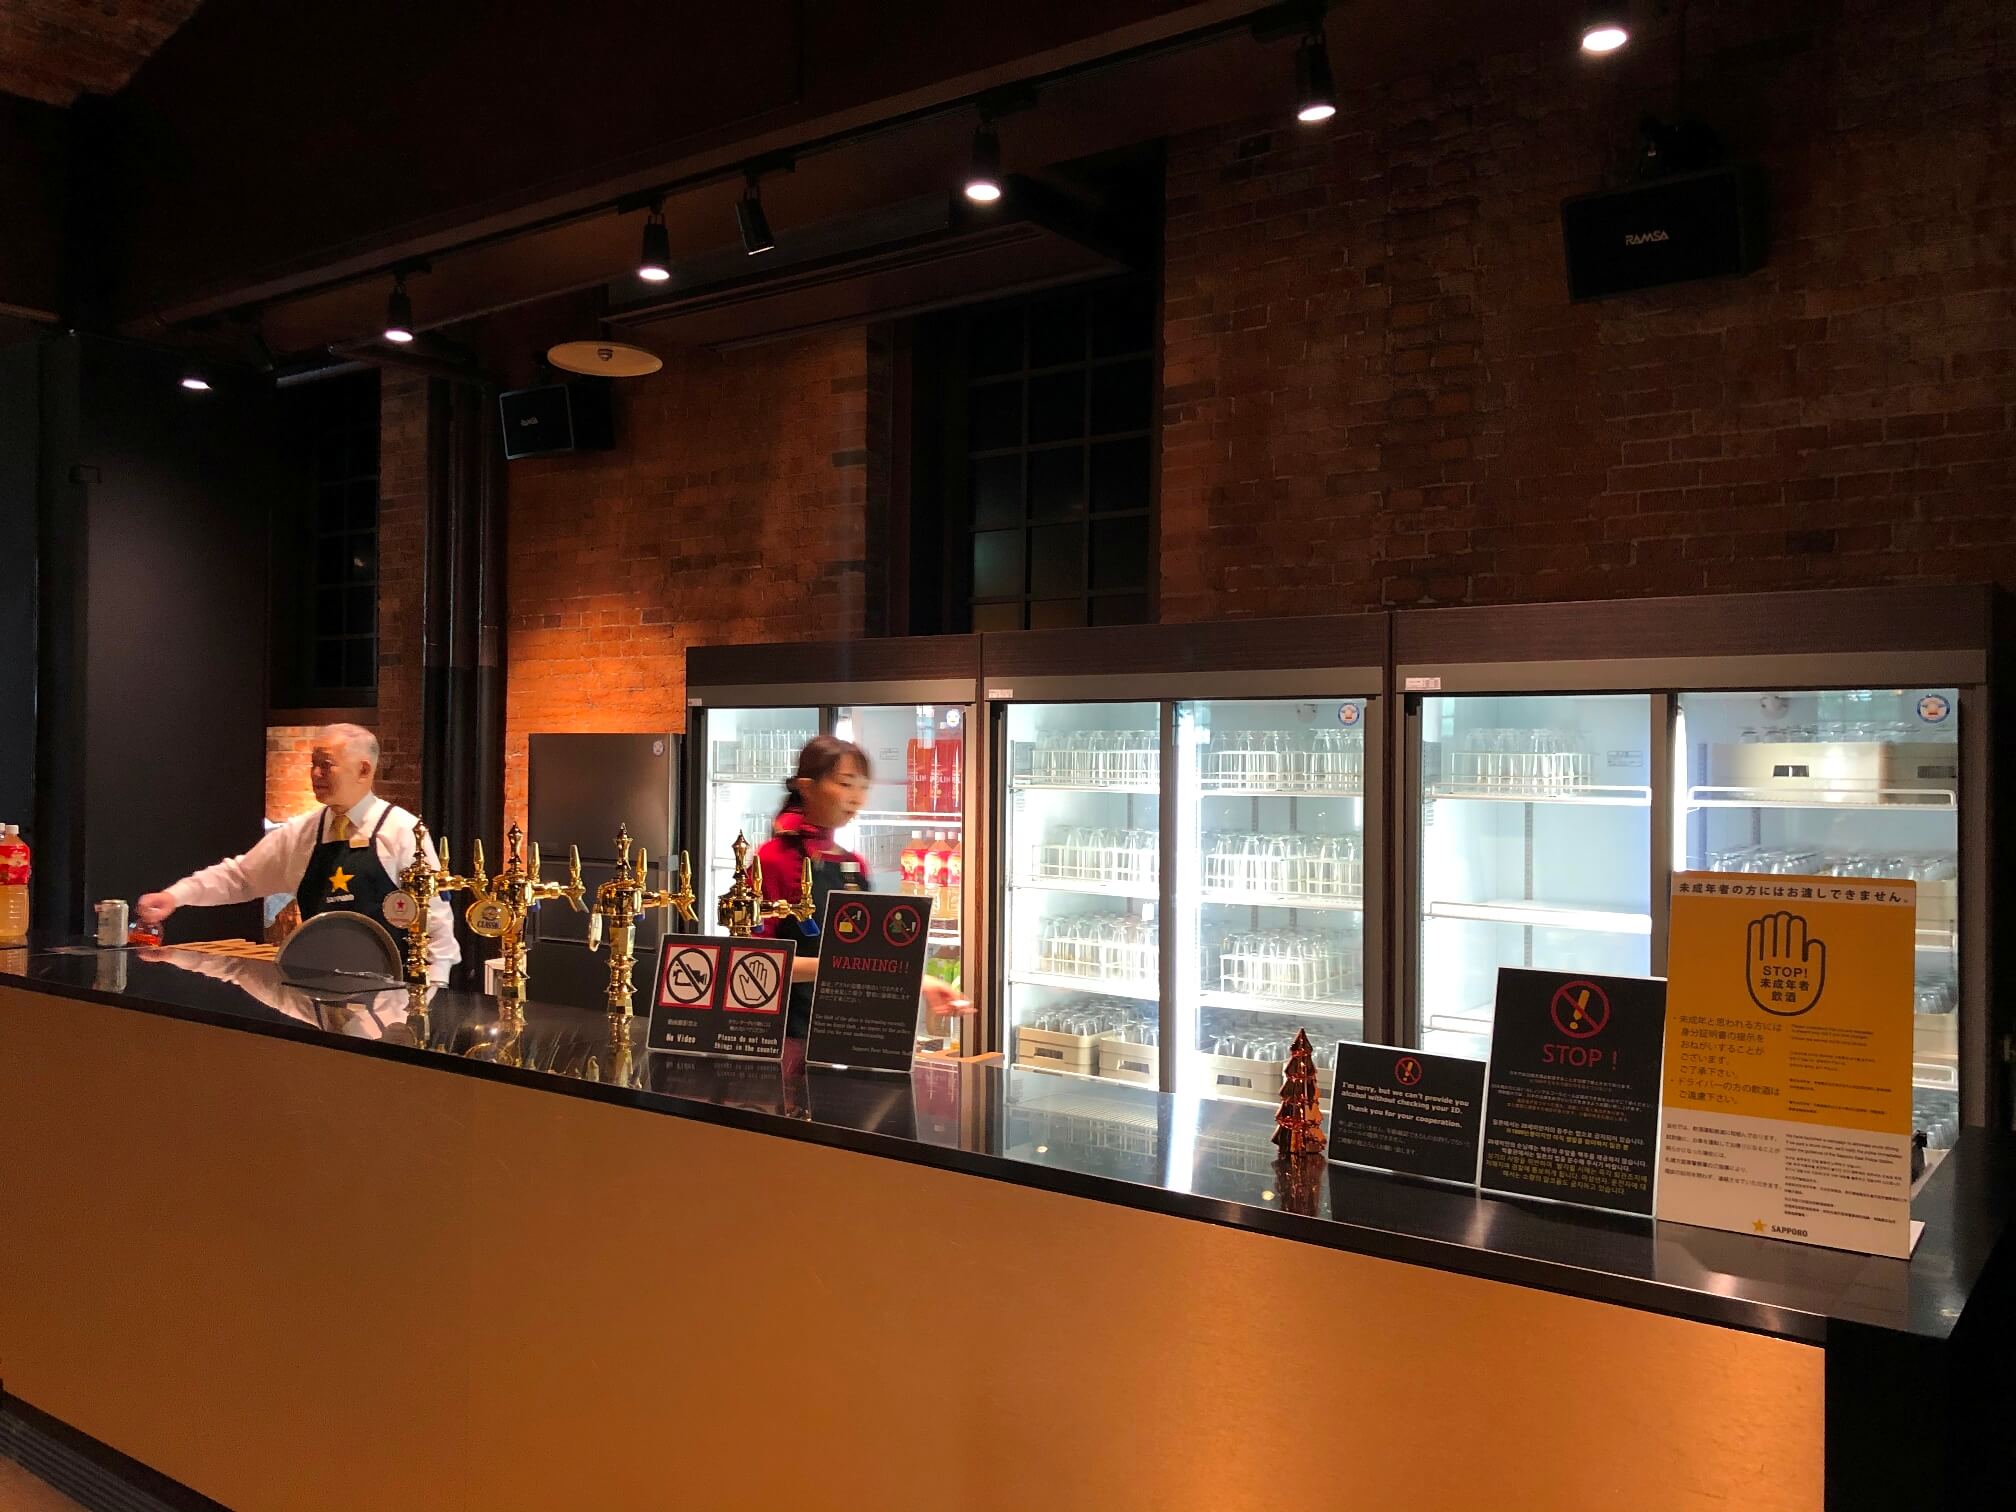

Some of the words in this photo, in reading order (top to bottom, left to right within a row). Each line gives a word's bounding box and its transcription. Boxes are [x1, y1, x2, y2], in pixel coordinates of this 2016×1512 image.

[1625, 230, 1669, 246] RAMSA
[1679, 883, 1908, 903] 未成年者の方にはお渡しできません。
[832, 956, 909, 974] WARNING!!
[1763, 966, 1807, 978] STOP!
[1760, 978, 1809, 991] 未成年者
[1772, 991, 1796, 1002] 飲酒
[677, 1033, 696, 1043] Video
[717, 1033, 737, 1042] Please
[739, 1035, 746, 1043] do
[748, 1036, 758, 1044] not
[762, 1037, 778, 1045] touch
[714, 1042, 733, 1051] things
[736, 1043, 742, 1051] in
[745, 1044, 754, 1052] the
[756, 1046, 780, 1054] counter
[1542, 1044, 1603, 1068] STOP
[1342, 1081, 1354, 1089] I'm
[1356, 1085, 1377, 1094] sorry,
[1378, 1087, 1391, 1095] but
[1404, 1092, 1422, 1100] can't
[1424, 1094, 1453, 1105] provide
[1341, 1089, 1367, 1099] alcohol
[1368, 1093, 1396, 1104] without
[1397, 1098, 1430, 1111] checking
[1431, 1104, 1449, 1112] your
[1346, 1103, 1368, 1113] Thank
[1370, 1108, 1384, 1116] you
[1384, 1109, 1396, 1117] for
[1397, 1112, 1414, 1120] your
[1415, 1115, 1463, 1129] cooperation.
[1771, 1225, 1808, 1237] SAPPORO
